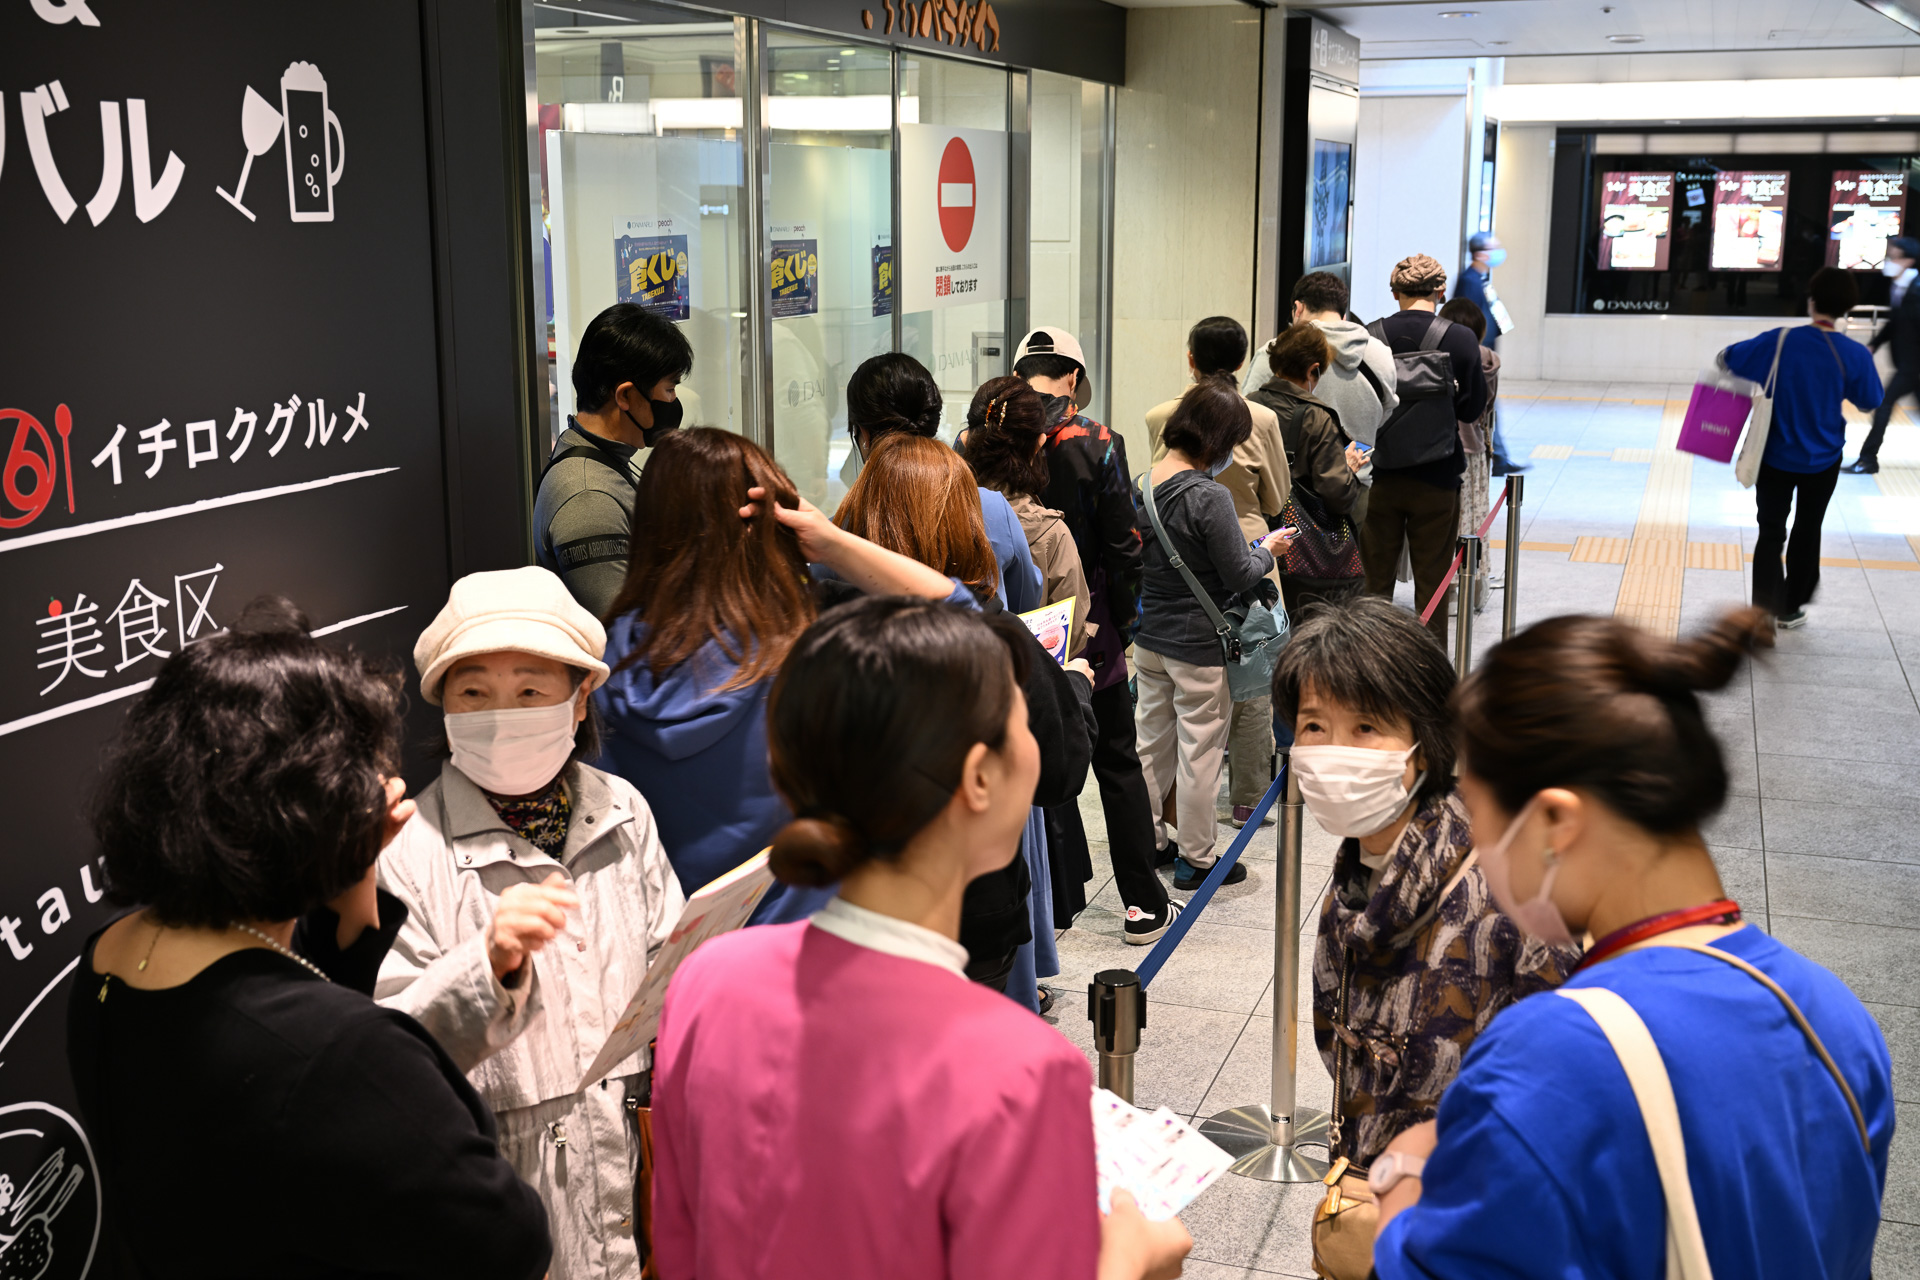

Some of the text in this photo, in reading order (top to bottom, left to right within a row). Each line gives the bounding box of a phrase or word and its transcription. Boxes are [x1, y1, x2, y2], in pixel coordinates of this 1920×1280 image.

[657, 218, 673, 230] peach
[793, 224, 806, 234] peach
[629, 247, 676, 295] 食くじ
[935, 274, 978, 298] 閉鎖しております
[1607, 300, 1669, 310] DAIMARU
[91, 392, 370, 485] イチロクグルメ
[35, 562, 230, 697] 美食区
